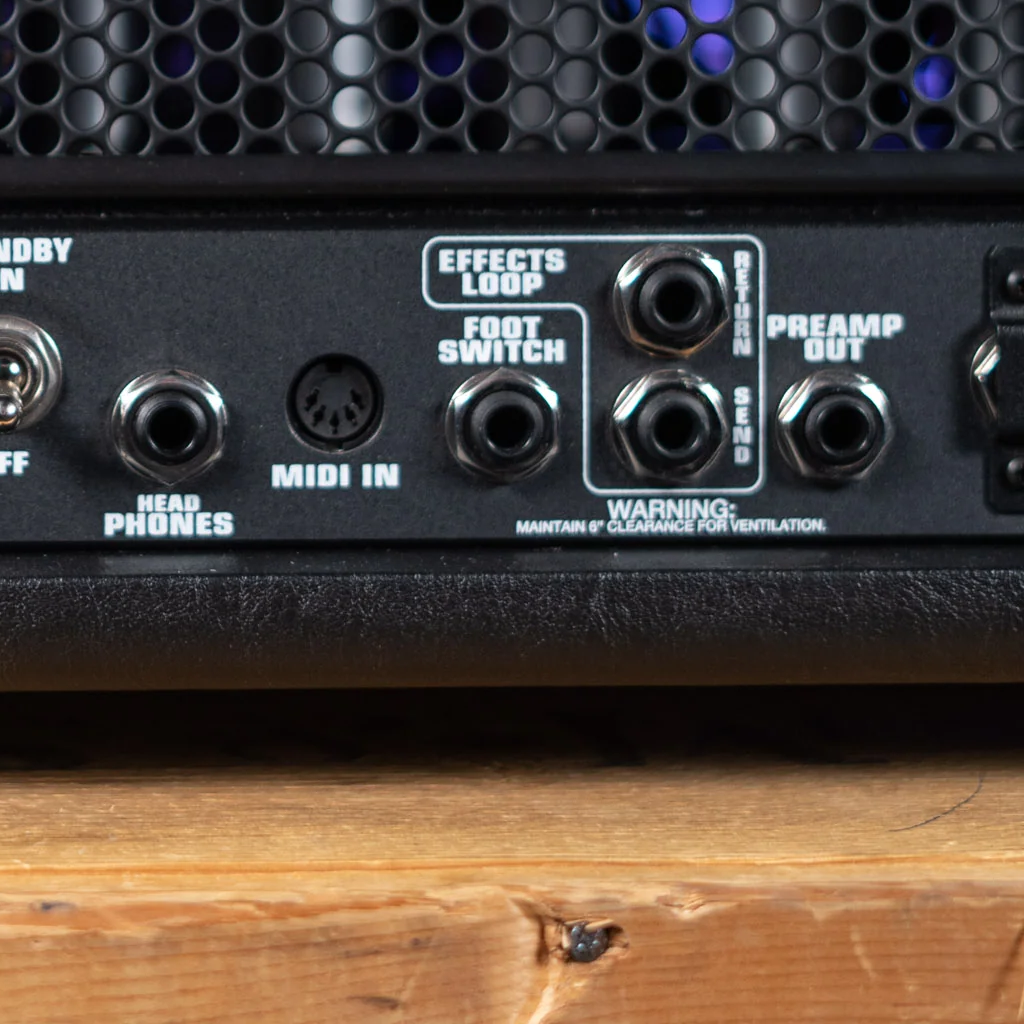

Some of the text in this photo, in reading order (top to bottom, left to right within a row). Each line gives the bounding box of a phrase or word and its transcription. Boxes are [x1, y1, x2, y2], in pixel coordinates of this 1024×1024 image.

[438, 249, 566, 273] EFFECTS
[462, 273, 544, 297] LOOP
[733, 250, 751, 358] RETURN
[464, 316, 540, 340] FOOT
[767, 314, 903, 339] PREAMP
[438, 340, 566, 364] SWITCH
[804, 338, 864, 362] OUT
[733, 387, 750, 465] SEND
[271, 464, 400, 488] MIDI IN
[136, 494, 201, 513] HEAD
[607, 499, 738, 521] WARNING:
[104, 513, 234, 537] PHONES
[516, 520, 586, 535] MAINTAIN
[606, 519, 694, 534] CLEARANCE
[697, 519, 728, 533] FOR
[729, 519, 826, 533] VENTILATION.
